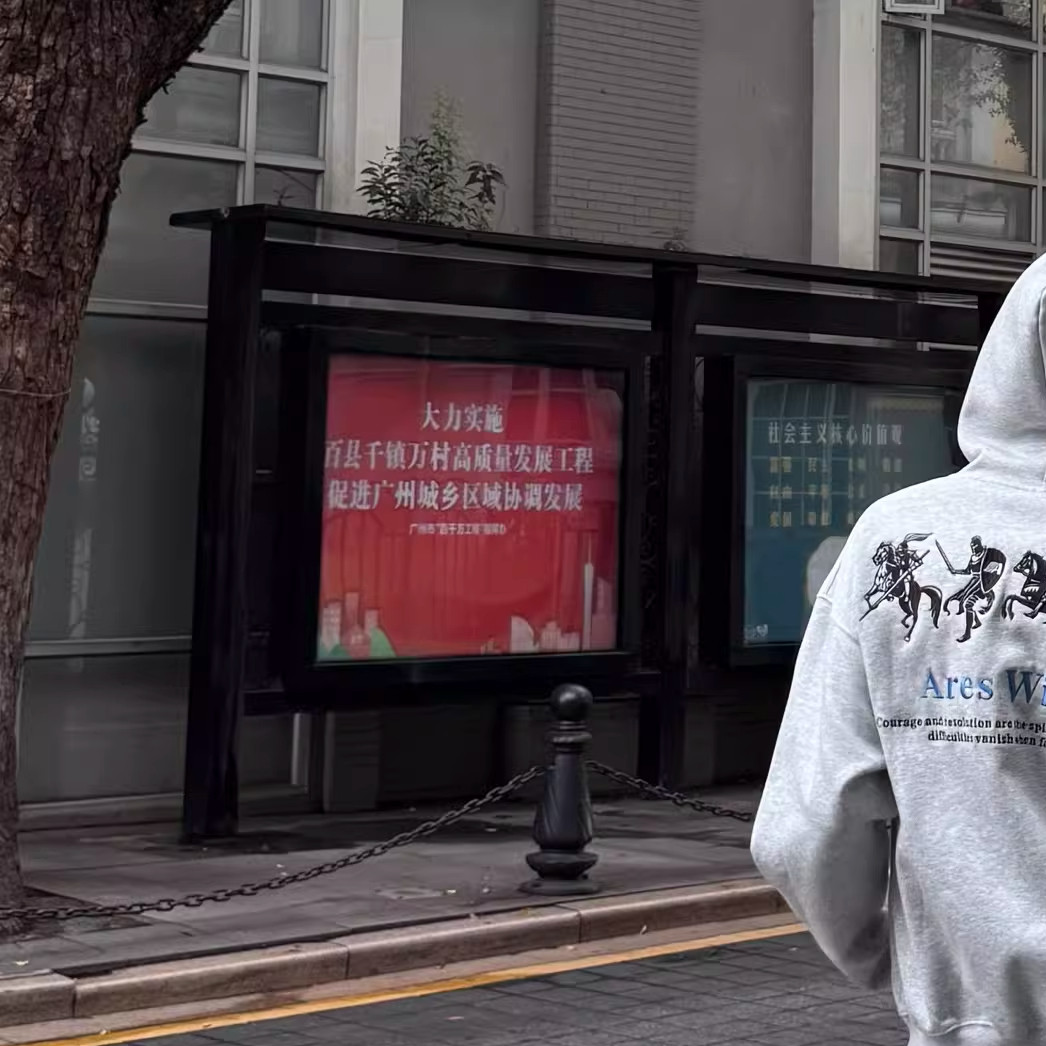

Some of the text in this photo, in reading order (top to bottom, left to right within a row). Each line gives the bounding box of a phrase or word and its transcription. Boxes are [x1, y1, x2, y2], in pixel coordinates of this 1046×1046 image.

[420, 401, 505, 433] 大力实施
[768, 421, 903, 445] 社会主义核心价值观
[324, 439, 593, 474] 百县千镇万村高质量发展工程
[328, 479, 583, 511] 促进广州城乡区域协调发展
[920, 667, 994, 701] Ares
[876, 717, 923, 730] Courage
[924, 716, 944, 727] and
[995, 720, 1013, 728] are
[975, 732, 1014, 745] vanish
